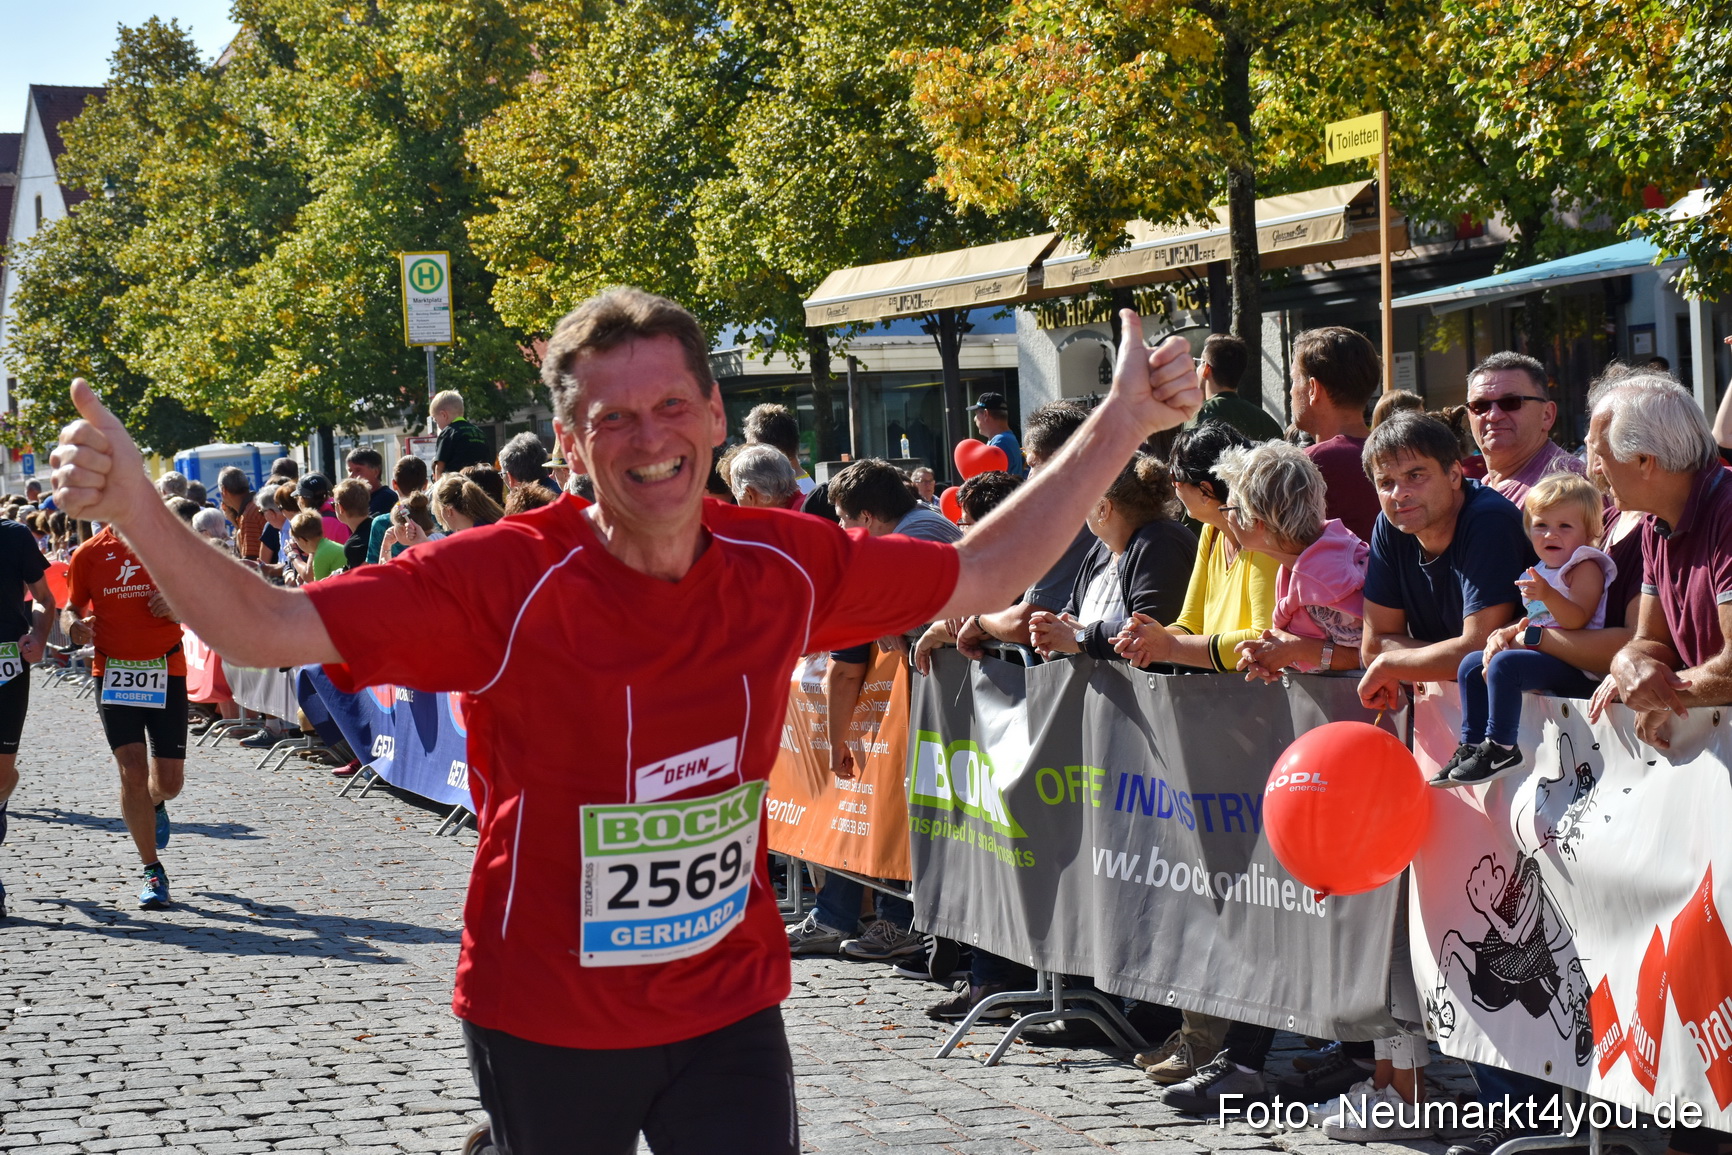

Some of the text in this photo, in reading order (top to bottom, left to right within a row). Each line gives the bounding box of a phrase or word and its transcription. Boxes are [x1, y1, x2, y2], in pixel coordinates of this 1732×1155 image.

[1336, 128, 1379, 150] Toiletten
[103, 583, 151, 597] funrunners
[117, 589, 157, 600] neumar
[111, 671, 159, 689] 2301
[115, 692, 154, 702] ROBERT
[663, 757, 710, 785] DEHN
[1265, 763, 1329, 797] RÖDL
[1288, 783, 1327, 793] energie
[1114, 772, 1264, 835] INDUSTRY
[601, 792, 746, 846] BOCK
[857, 821, 871, 837] 897
[607, 841, 743, 910] 2569
[610, 900, 735, 947] GERHARD
